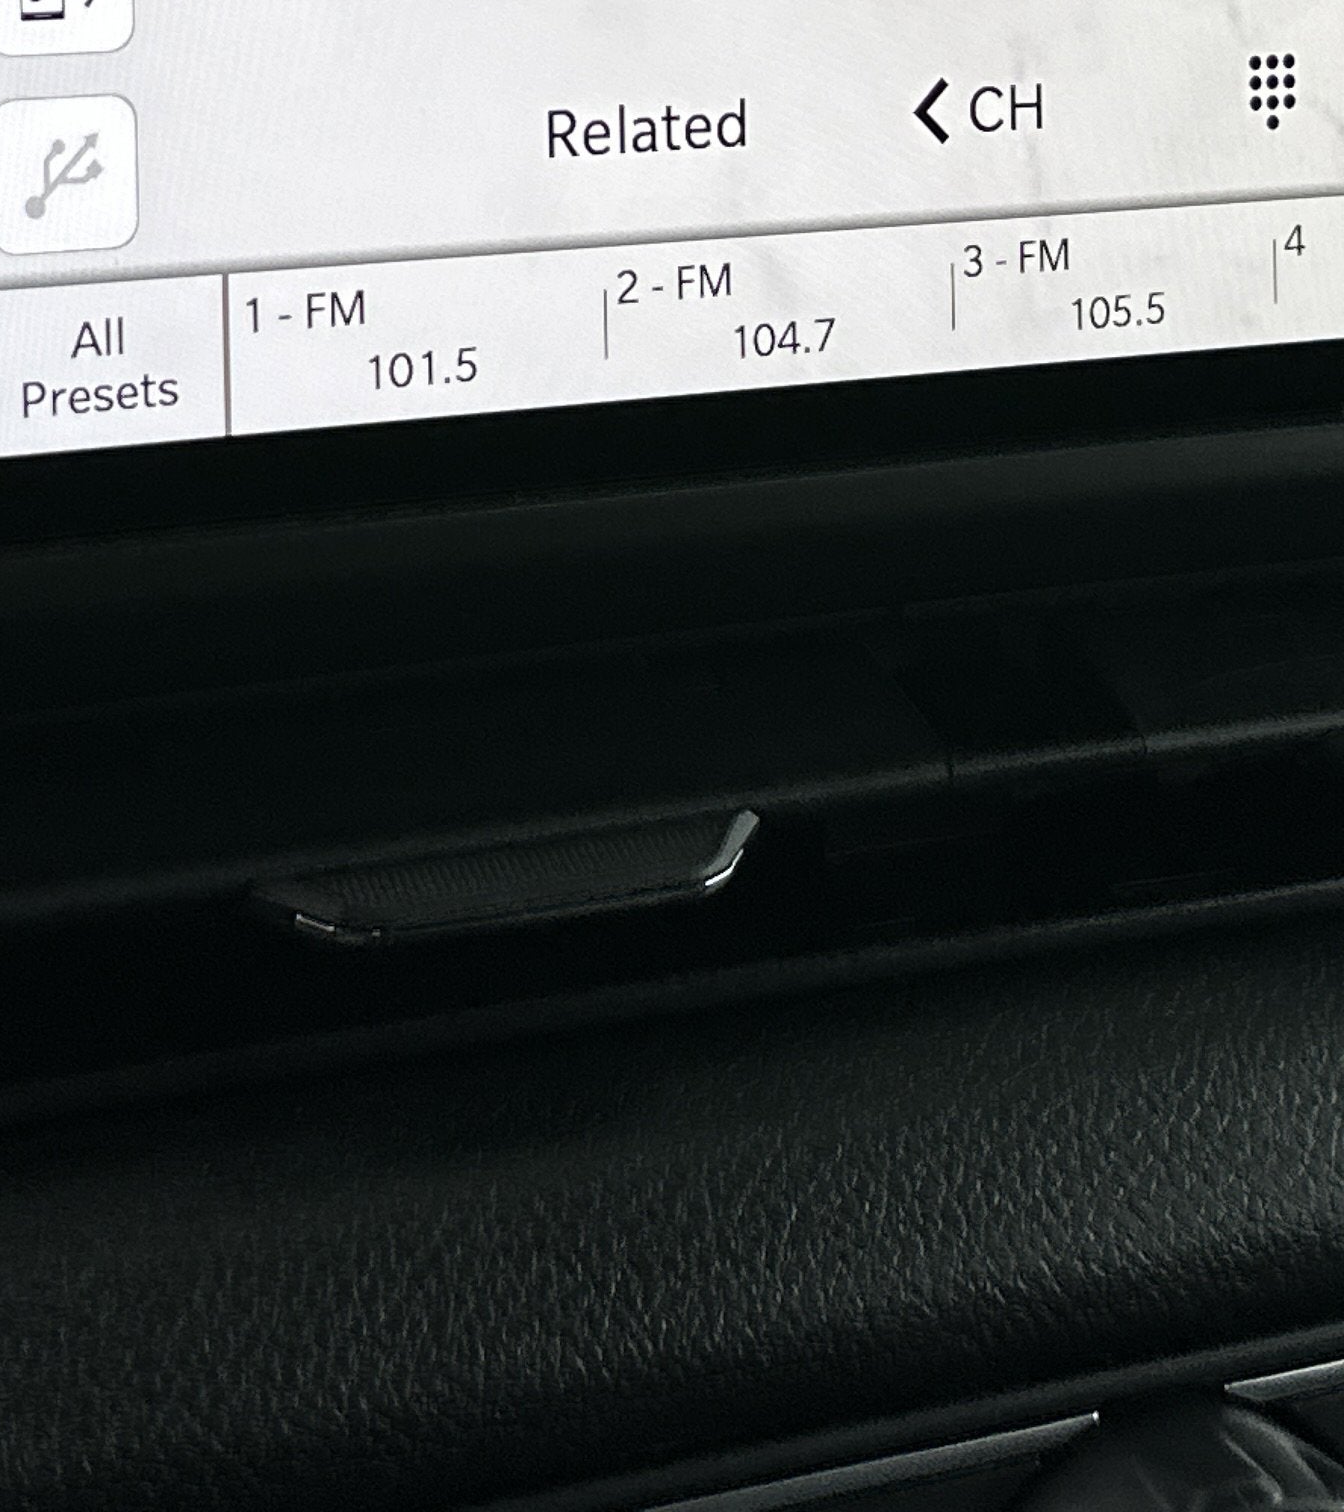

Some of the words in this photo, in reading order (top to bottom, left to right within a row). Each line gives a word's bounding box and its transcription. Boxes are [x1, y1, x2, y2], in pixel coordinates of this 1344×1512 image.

[547, 97, 746, 158] Related
[969, 83, 1043, 133] CH
[963, 244, 983, 278] 3
[1019, 237, 1070, 274] FM
[1284, 224, 1306, 256] 4
[617, 269, 639, 305] 2
[677, 262, 732, 301] FM
[246, 297, 260, 334] 1
[306, 289, 365, 329] FM
[1071, 291, 1165, 331] 105.5
[71, 317, 124, 359] All
[734, 317, 836, 359] 104.7
[368, 346, 478, 390] 101.5
[22, 374, 179, 418] Presets
